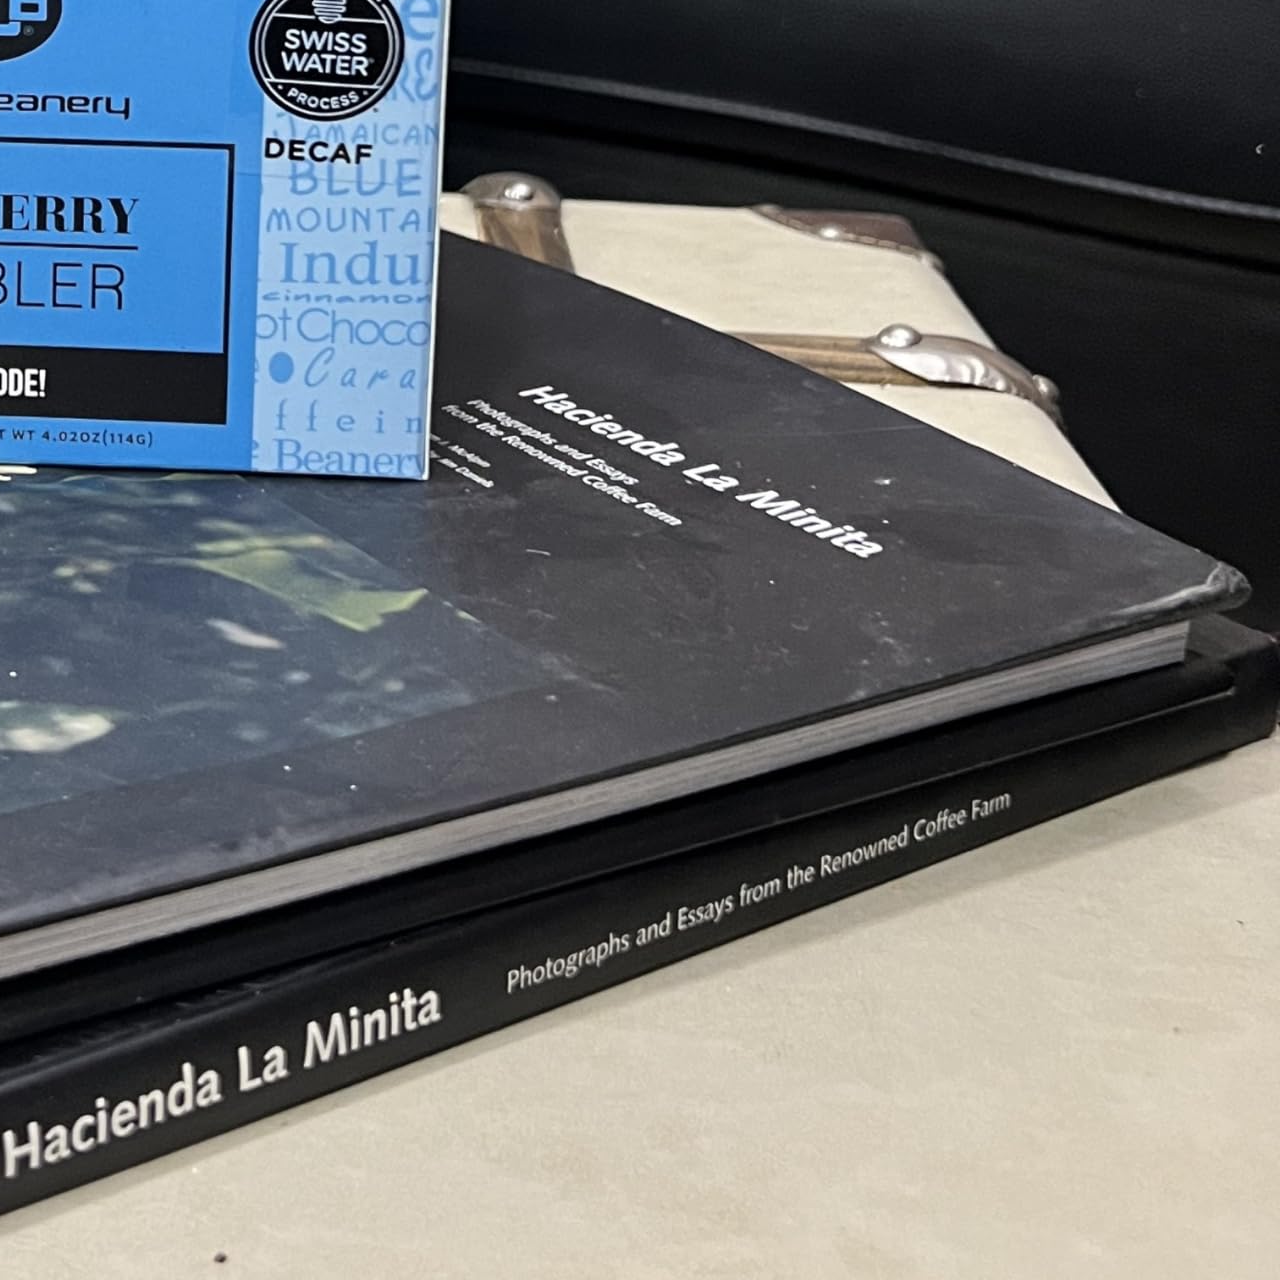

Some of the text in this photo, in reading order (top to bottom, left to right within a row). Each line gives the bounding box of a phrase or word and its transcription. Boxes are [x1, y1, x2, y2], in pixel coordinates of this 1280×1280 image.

[284, 28, 368, 54] SWISS
[281, 51, 369, 77] WATER
[286, 87, 360, 110] PROCESS
[264, 137, 373, 165] DECAF
[289, 158, 422, 197] BLUE
[304, 347, 417, 390] Cara
[12, 429, 35, 441] WT
[41, 430, 154, 448] 4.02OZ(114G)
[441, 404, 682, 526] from the Renowned Coffee Farm
[518, 386, 884, 558] Hacienda La Minita
[554, 444, 593, 461] and
[586, 458, 639, 486] Essays
[2, 791, 1011, 1178] Hacienda La Minita Photographs and Essays from the Renowned Coffee Farm
